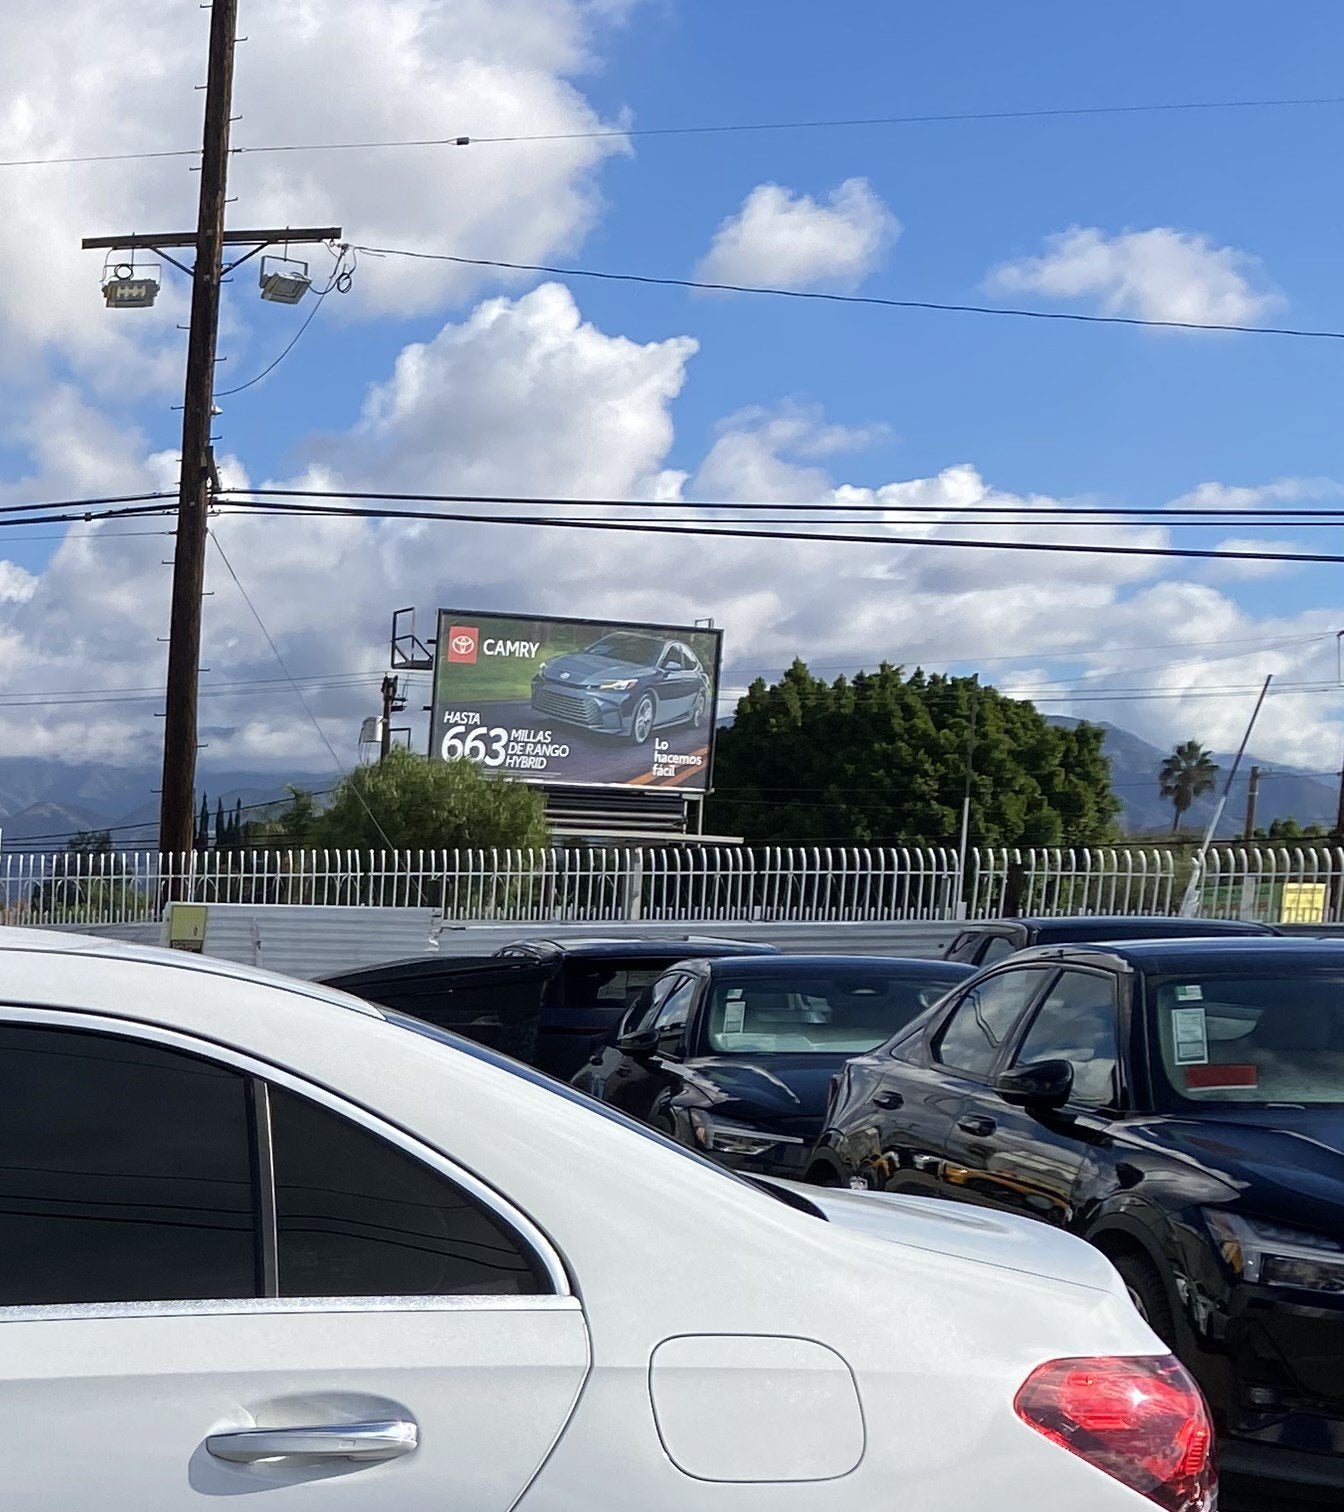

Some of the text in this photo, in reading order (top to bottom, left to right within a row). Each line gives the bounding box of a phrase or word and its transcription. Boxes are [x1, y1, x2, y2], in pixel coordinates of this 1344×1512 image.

[483, 638, 540, 659] CAMRY
[443, 710, 481, 725] HASTA
[510, 729, 552, 743] MILLAS
[655, 737, 669, 750] Lo
[441, 725, 509, 767] 663
[507, 742, 570, 757] DE RANGO
[505, 755, 547, 769] HYBRID
[654, 750, 702, 766] hacemos
